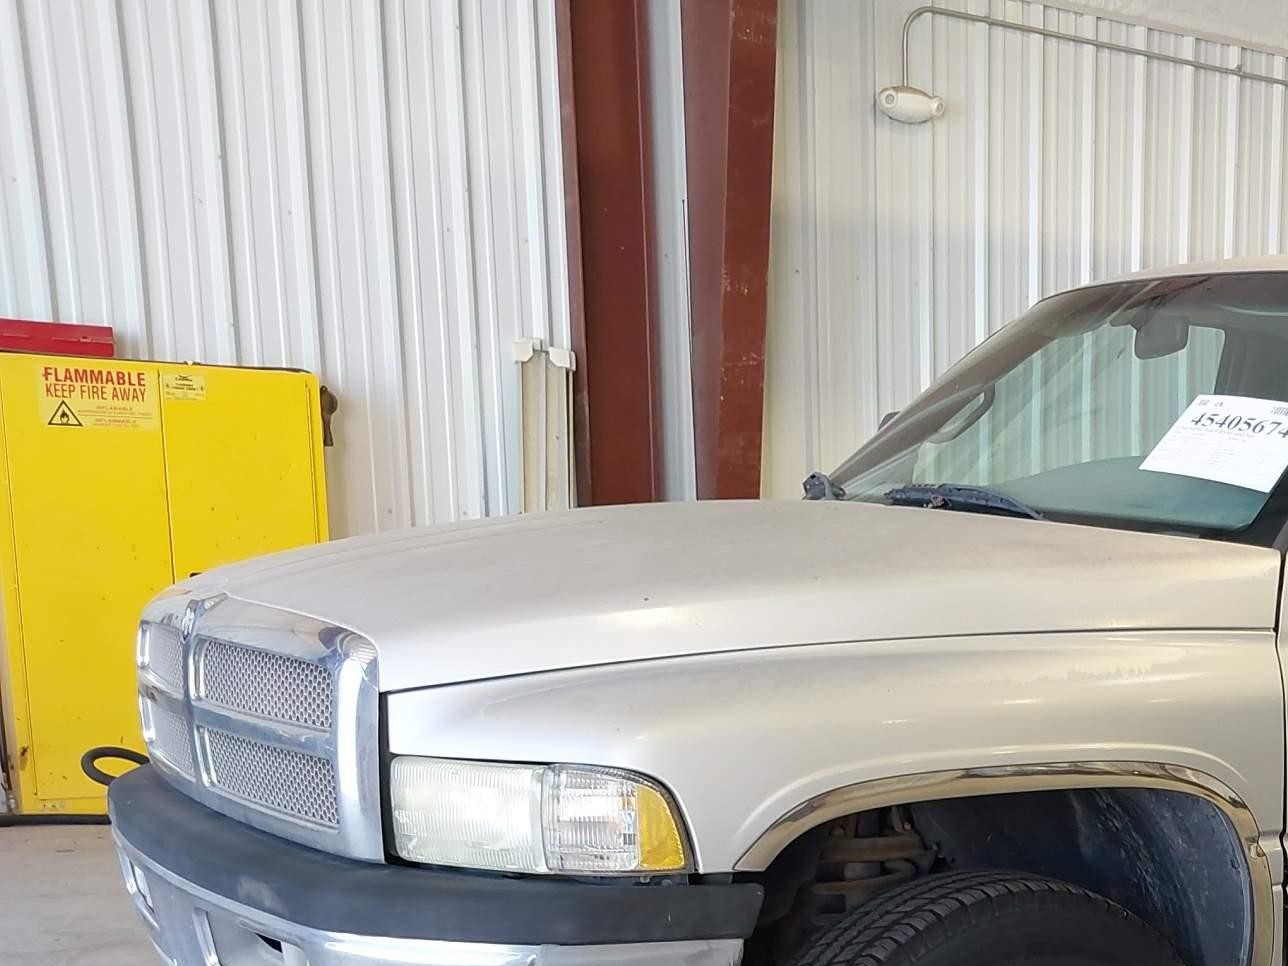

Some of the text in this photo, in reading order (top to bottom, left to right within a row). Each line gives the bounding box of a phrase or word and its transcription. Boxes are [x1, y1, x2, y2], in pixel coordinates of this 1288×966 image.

[43, 366, 146, 387] FLAMMABLE
[45, 382, 76, 399] KEEP
[80, 384, 108, 401] FIRE
[111, 386, 146, 403] AWAY
